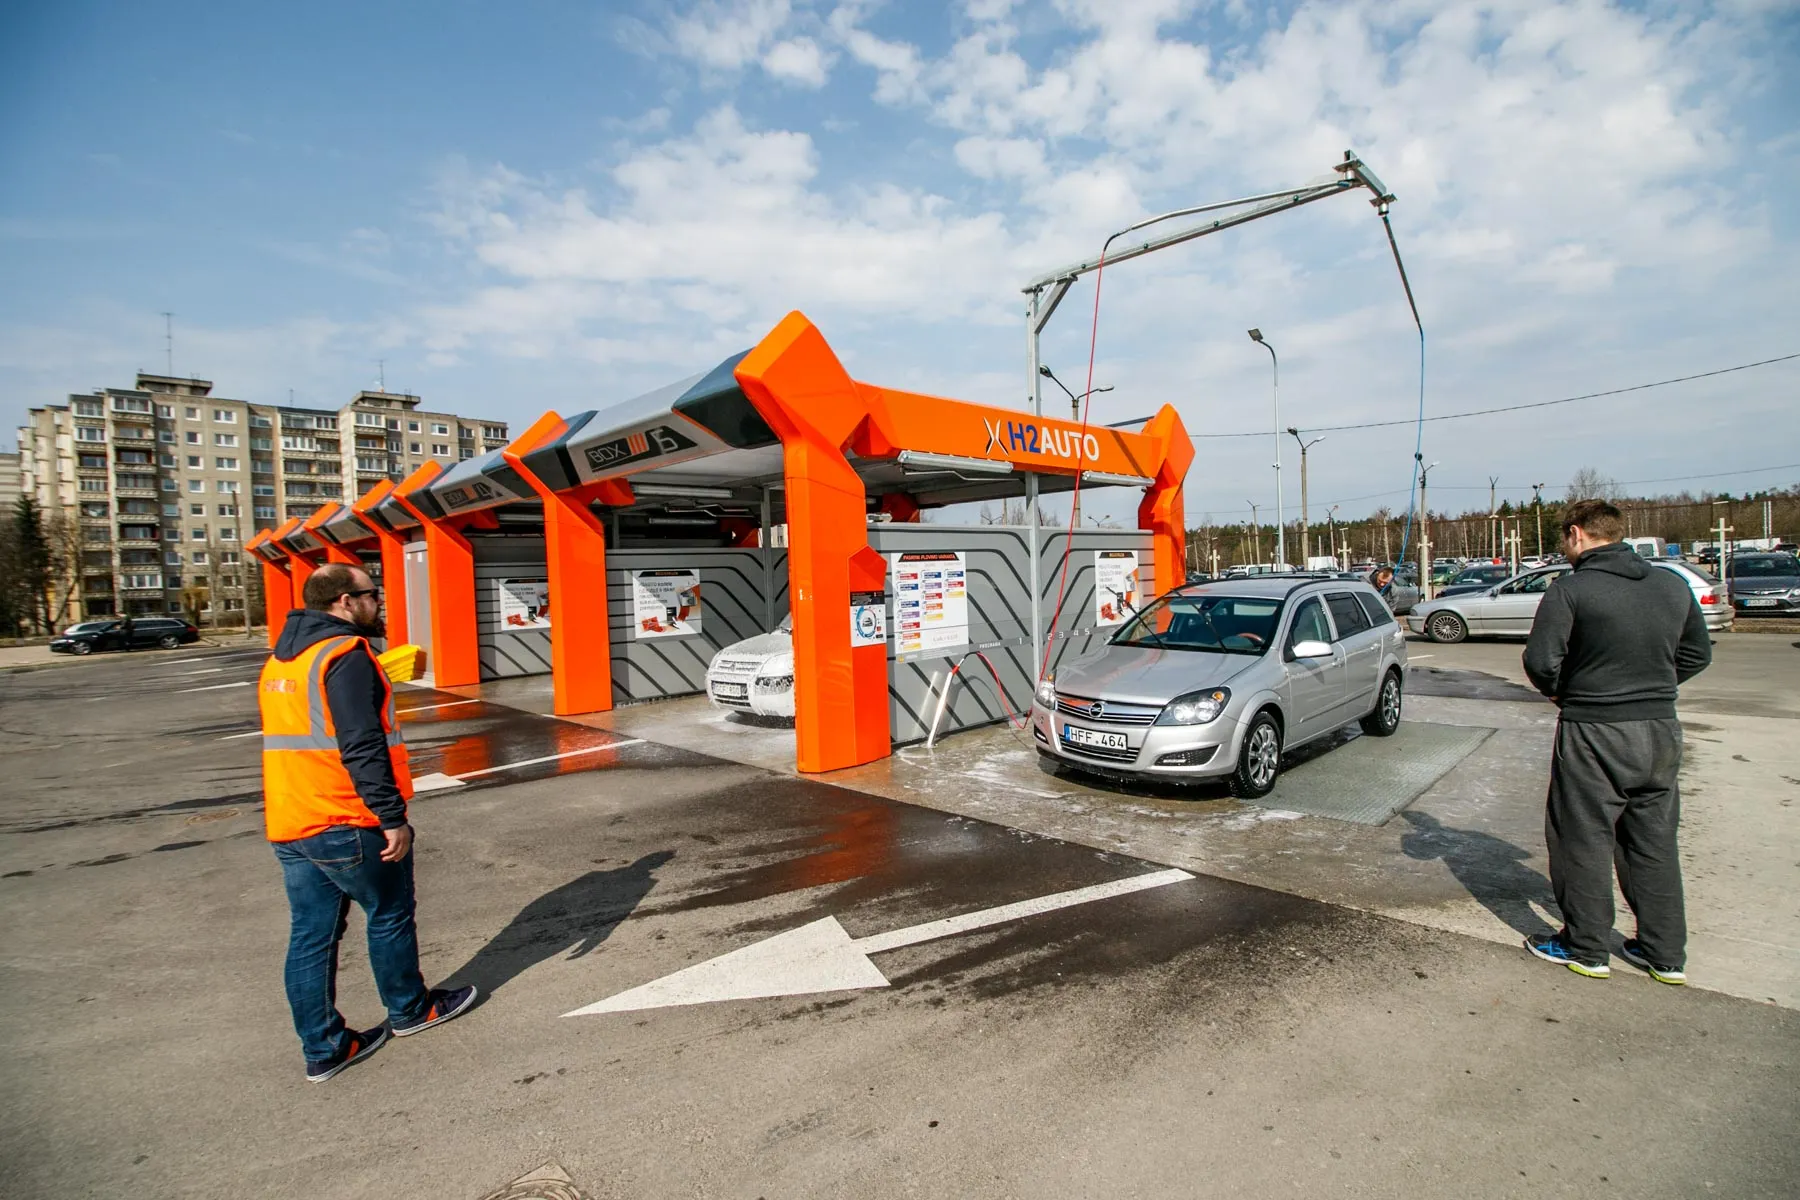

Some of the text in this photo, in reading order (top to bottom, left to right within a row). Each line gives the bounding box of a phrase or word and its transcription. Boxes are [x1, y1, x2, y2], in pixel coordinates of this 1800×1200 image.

[1008, 421, 1100, 461] H2AUTO
[588, 443, 627, 463] BOX
[1018, 637, 1022, 645] 1
[1047, 633, 1053, 641] 2
[1058, 631, 1064, 639] 3
[1073, 629, 1079, 637] 4
[1084, 628, 1090, 636] 5
[1070, 728, 1093, 743] HFF
[1101, 734, 1124, 748] 464
